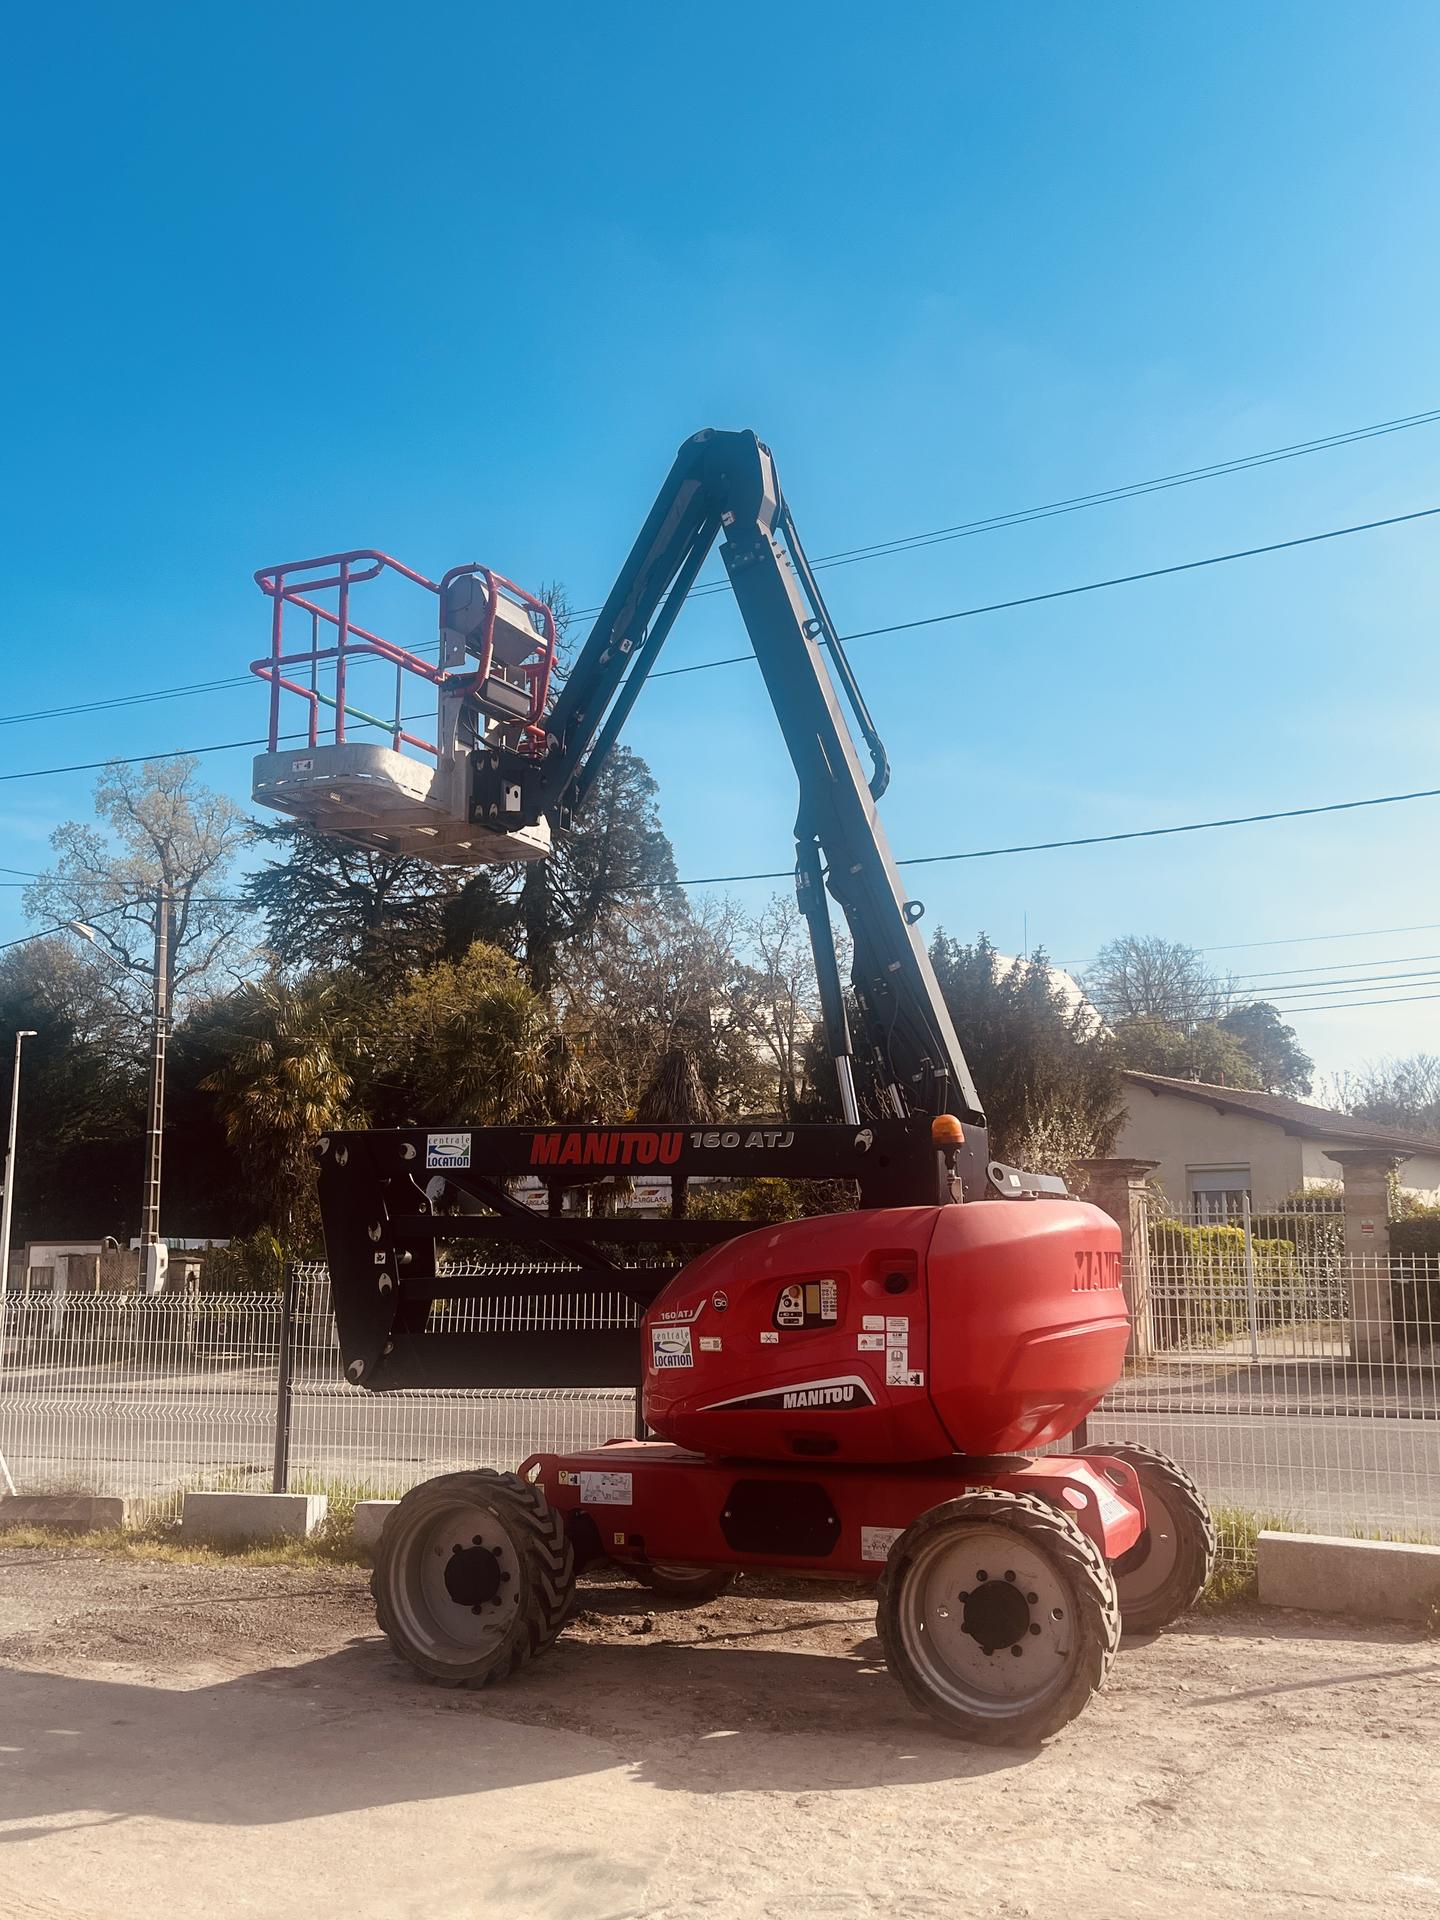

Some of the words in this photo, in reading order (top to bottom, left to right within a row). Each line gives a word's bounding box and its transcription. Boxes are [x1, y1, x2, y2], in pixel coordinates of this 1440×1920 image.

[428, 1135, 470, 1145] centrale
[529, 1132, 684, 1165] MANITOU
[690, 1132, 740, 1148] 160
[745, 1132, 795, 1148] ATJ
[427, 1156, 470, 1167] LOCATION
[1072, 1251, 1122, 1292] MANIT
[661, 1311, 677, 1320] 160
[677, 1310, 693, 1319] ATJ
[654, 1354, 693, 1367] LOCATION
[783, 1385, 854, 1409] MANITOU
